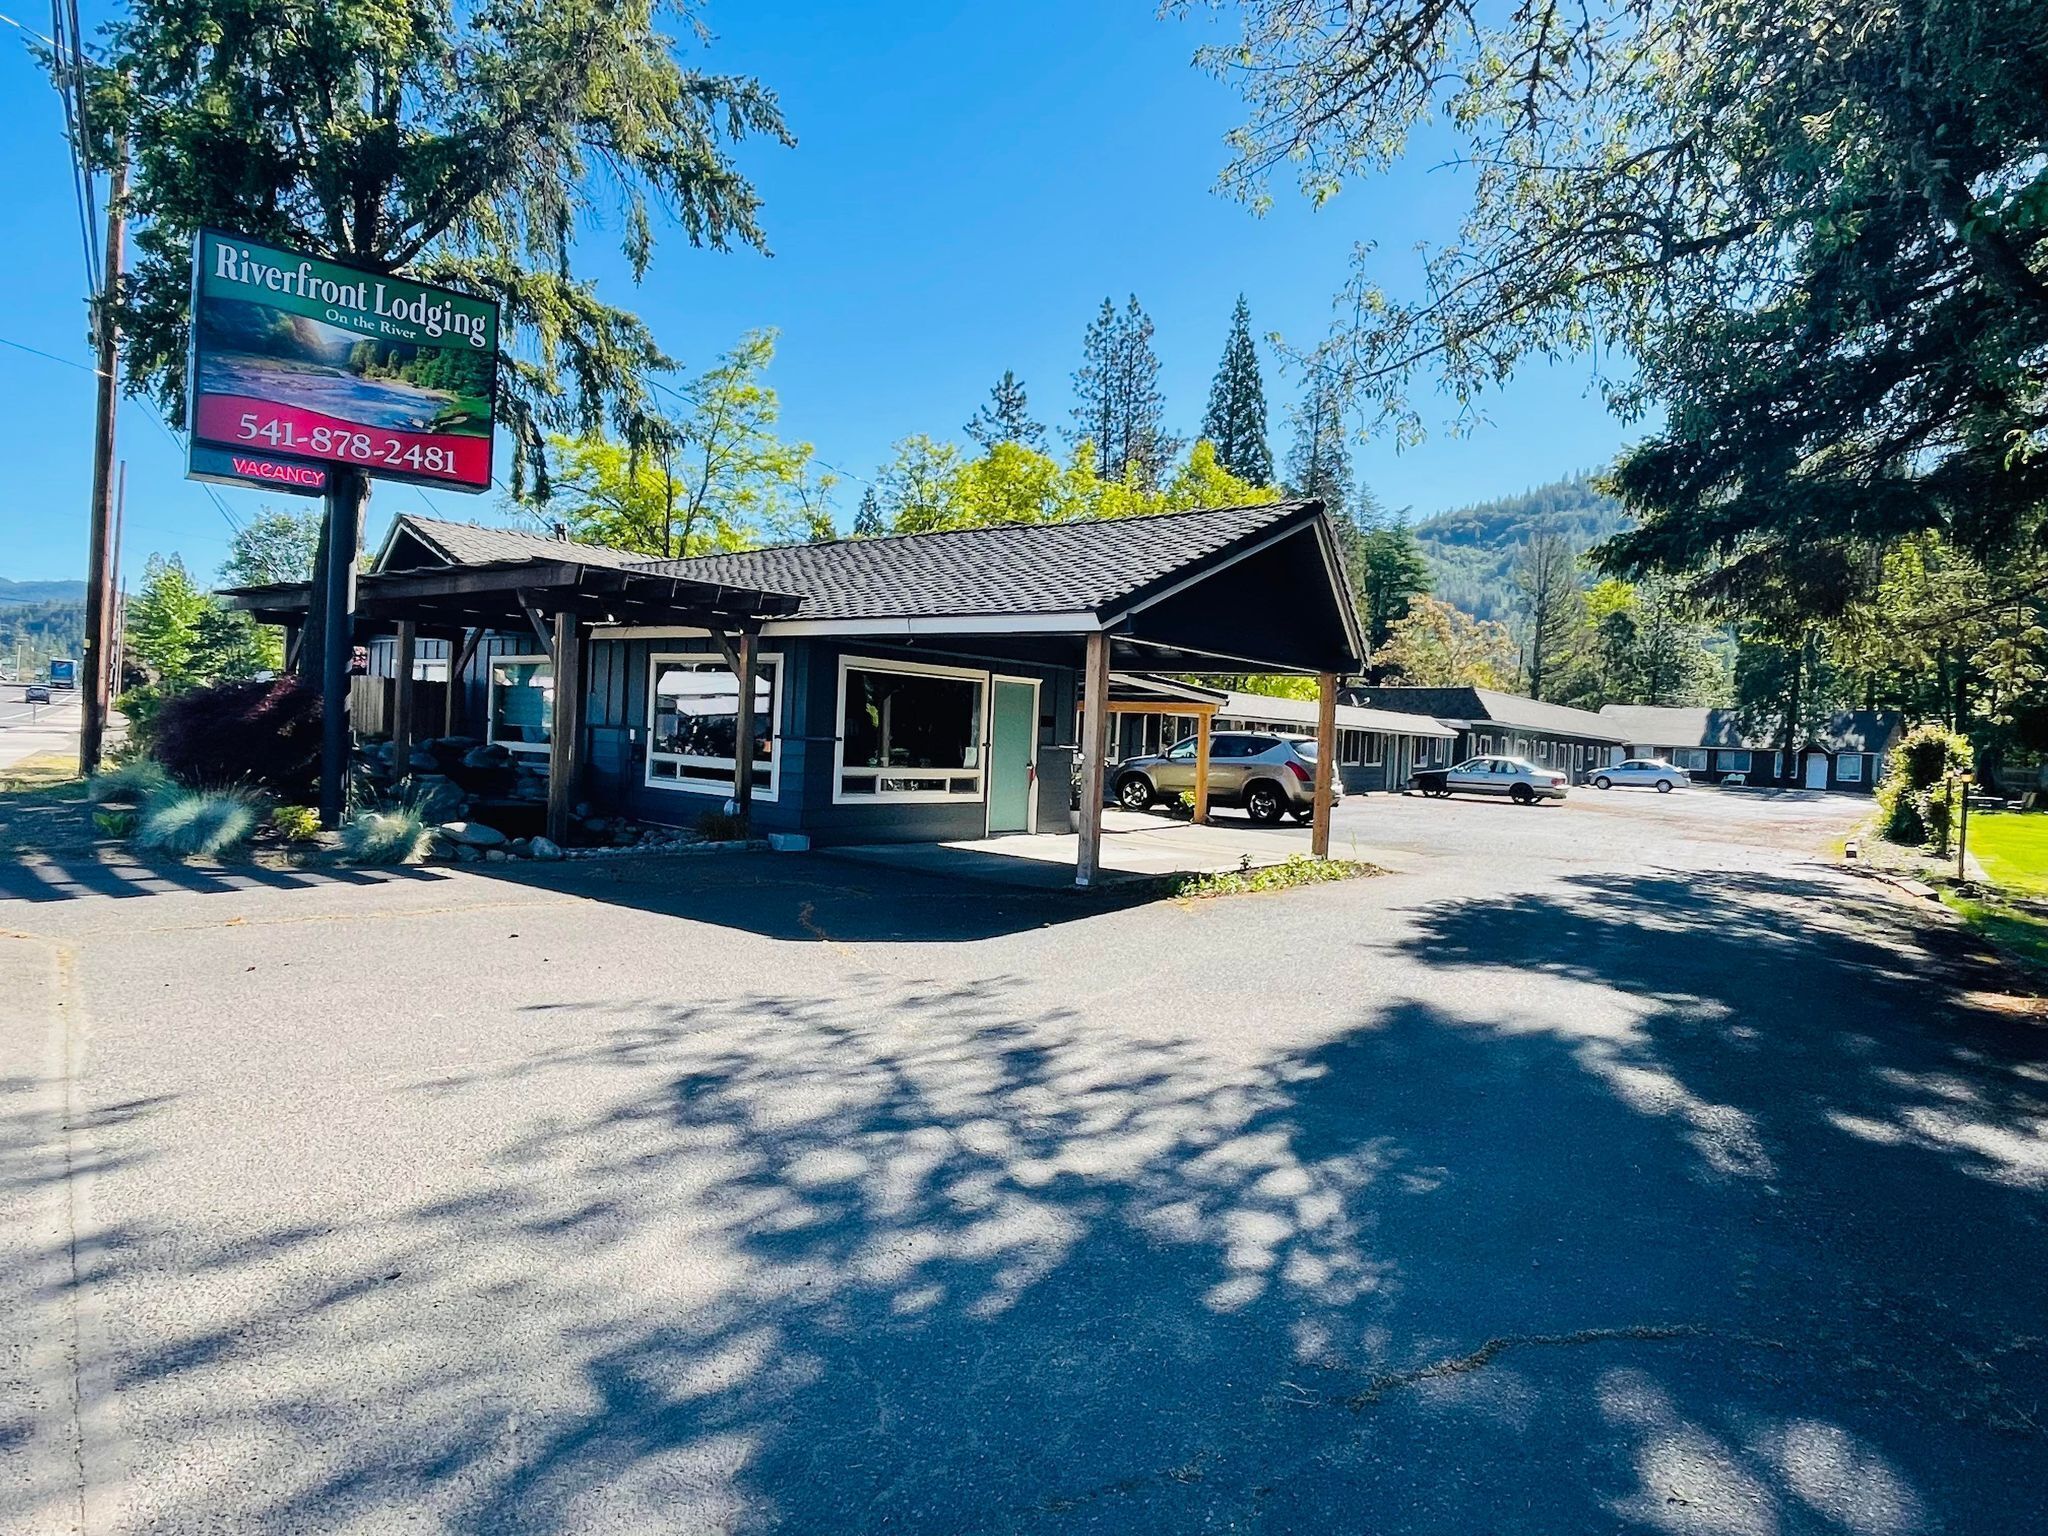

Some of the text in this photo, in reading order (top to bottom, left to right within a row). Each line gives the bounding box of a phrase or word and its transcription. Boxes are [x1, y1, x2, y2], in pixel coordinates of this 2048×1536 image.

[215, 243, 487, 348] Riverfront Lodging
[325, 309, 416, 340] On the River
[236, 413, 457, 474] 541-878-2481
[232, 458, 325, 486] VACANCY
